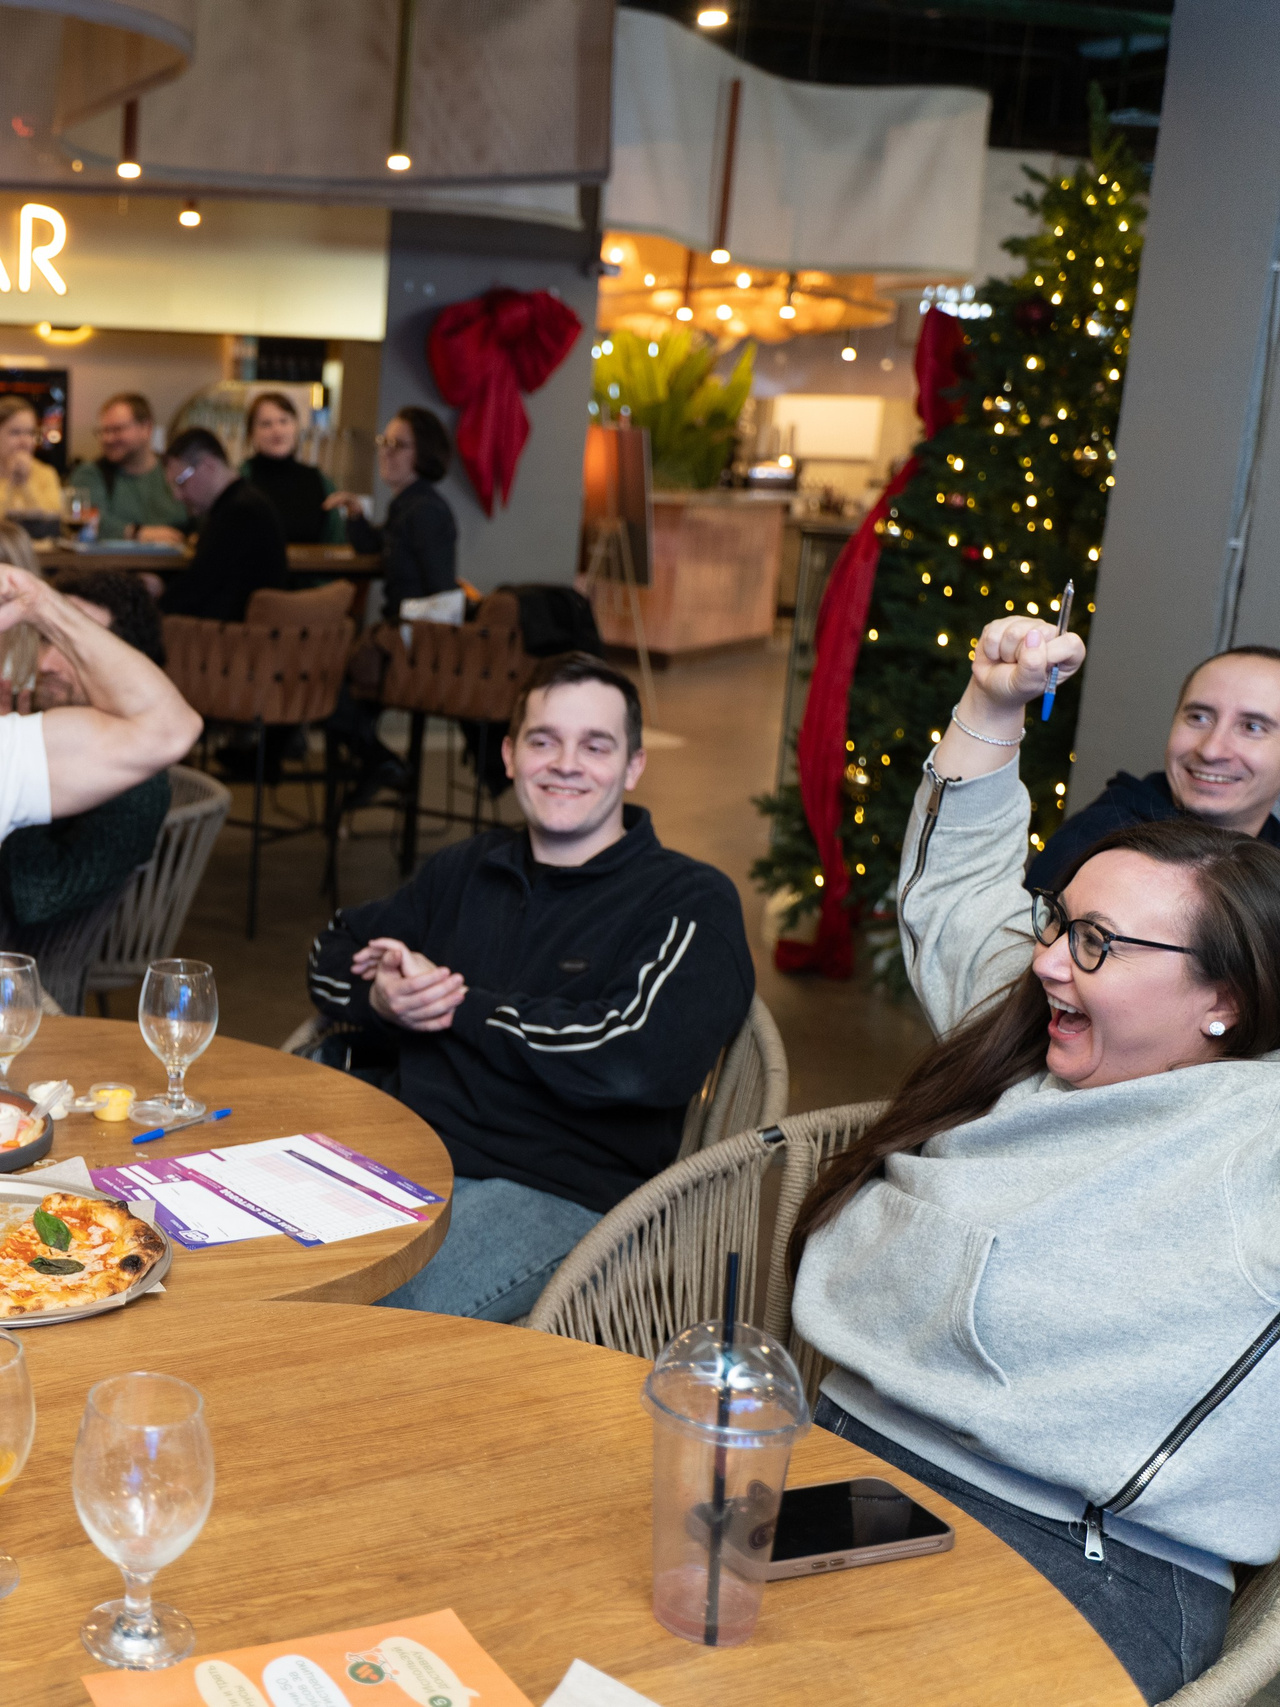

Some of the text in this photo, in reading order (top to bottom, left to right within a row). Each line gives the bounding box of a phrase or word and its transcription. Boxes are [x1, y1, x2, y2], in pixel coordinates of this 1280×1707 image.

[275, 1676, 293, 1692] 50
[391, 1646, 436, 1694] Используй
[411, 1650, 451, 1690] доставку
